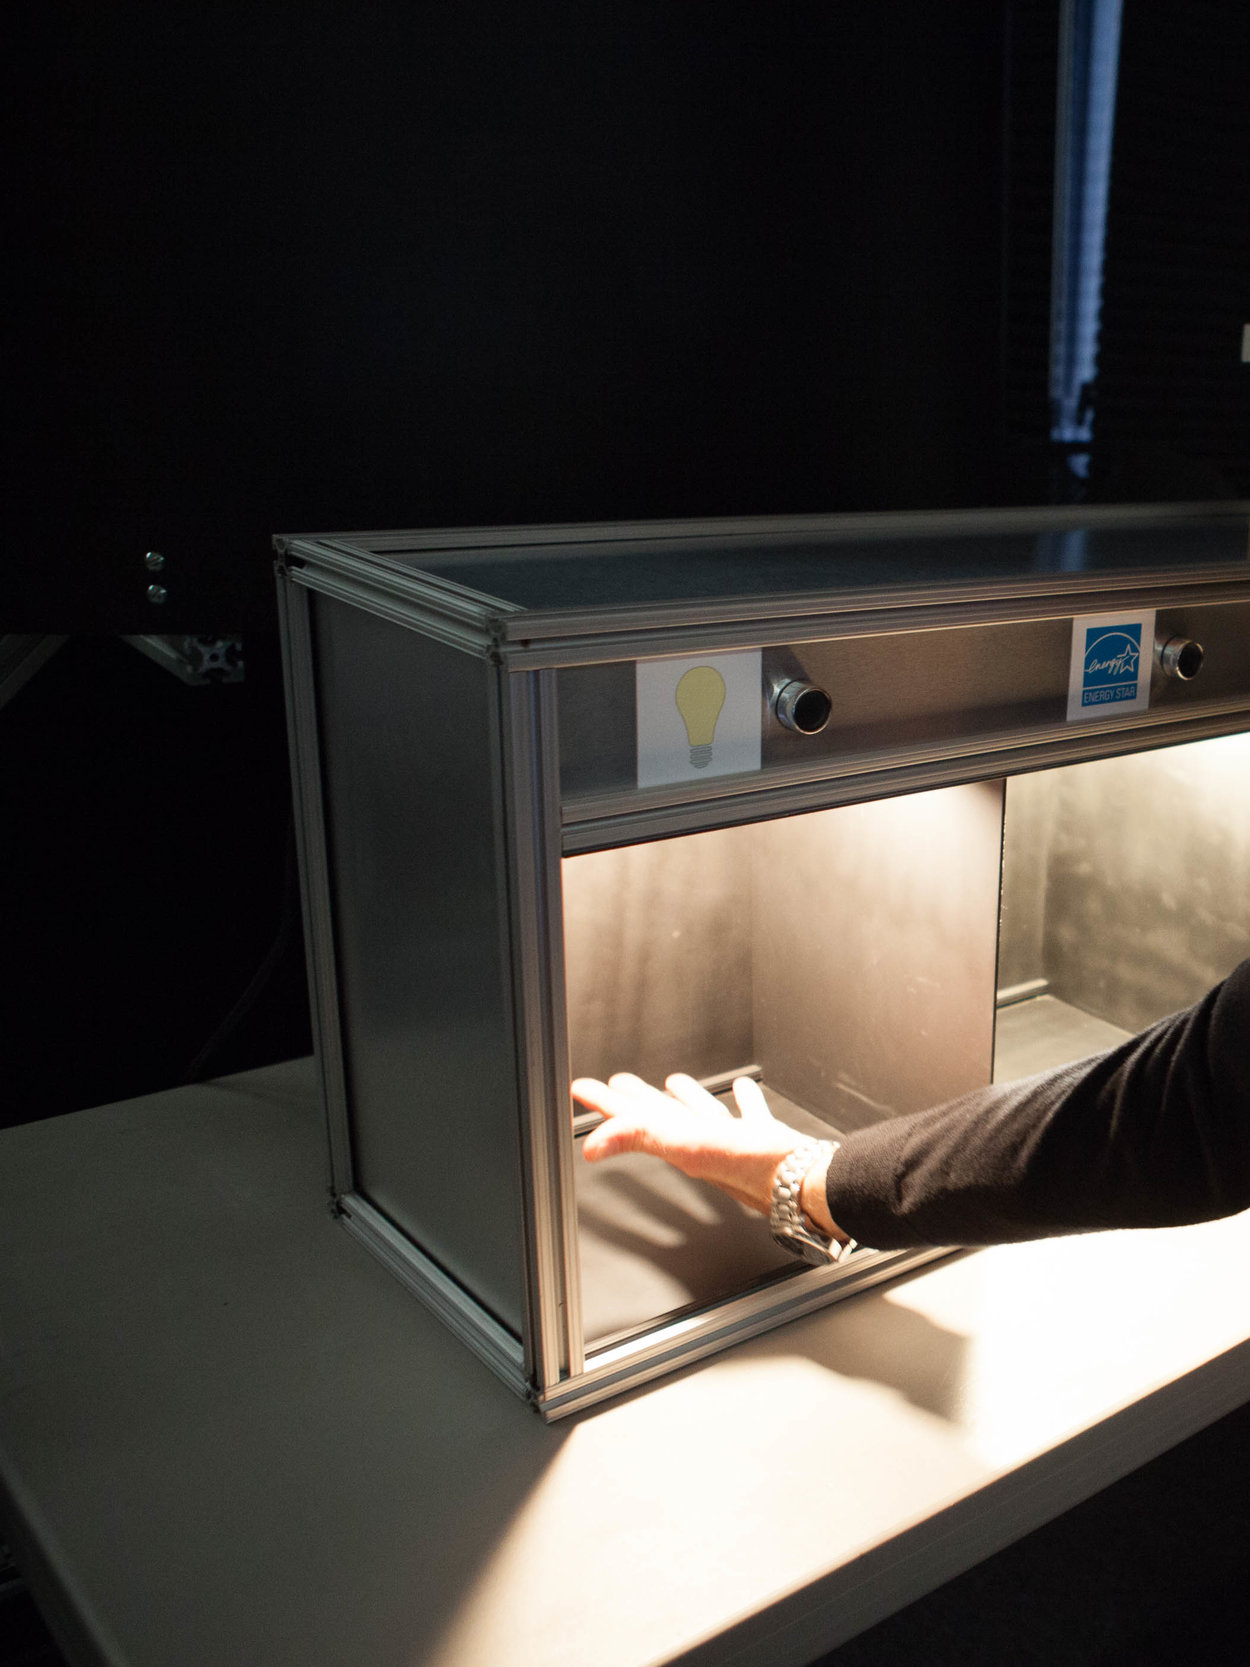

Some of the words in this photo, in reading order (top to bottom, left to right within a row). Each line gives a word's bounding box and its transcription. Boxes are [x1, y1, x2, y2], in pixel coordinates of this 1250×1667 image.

[1085, 658, 1122, 675] energy
[1083, 690, 1114, 704] ENERGY
[1115, 686, 1135, 700] STAR
